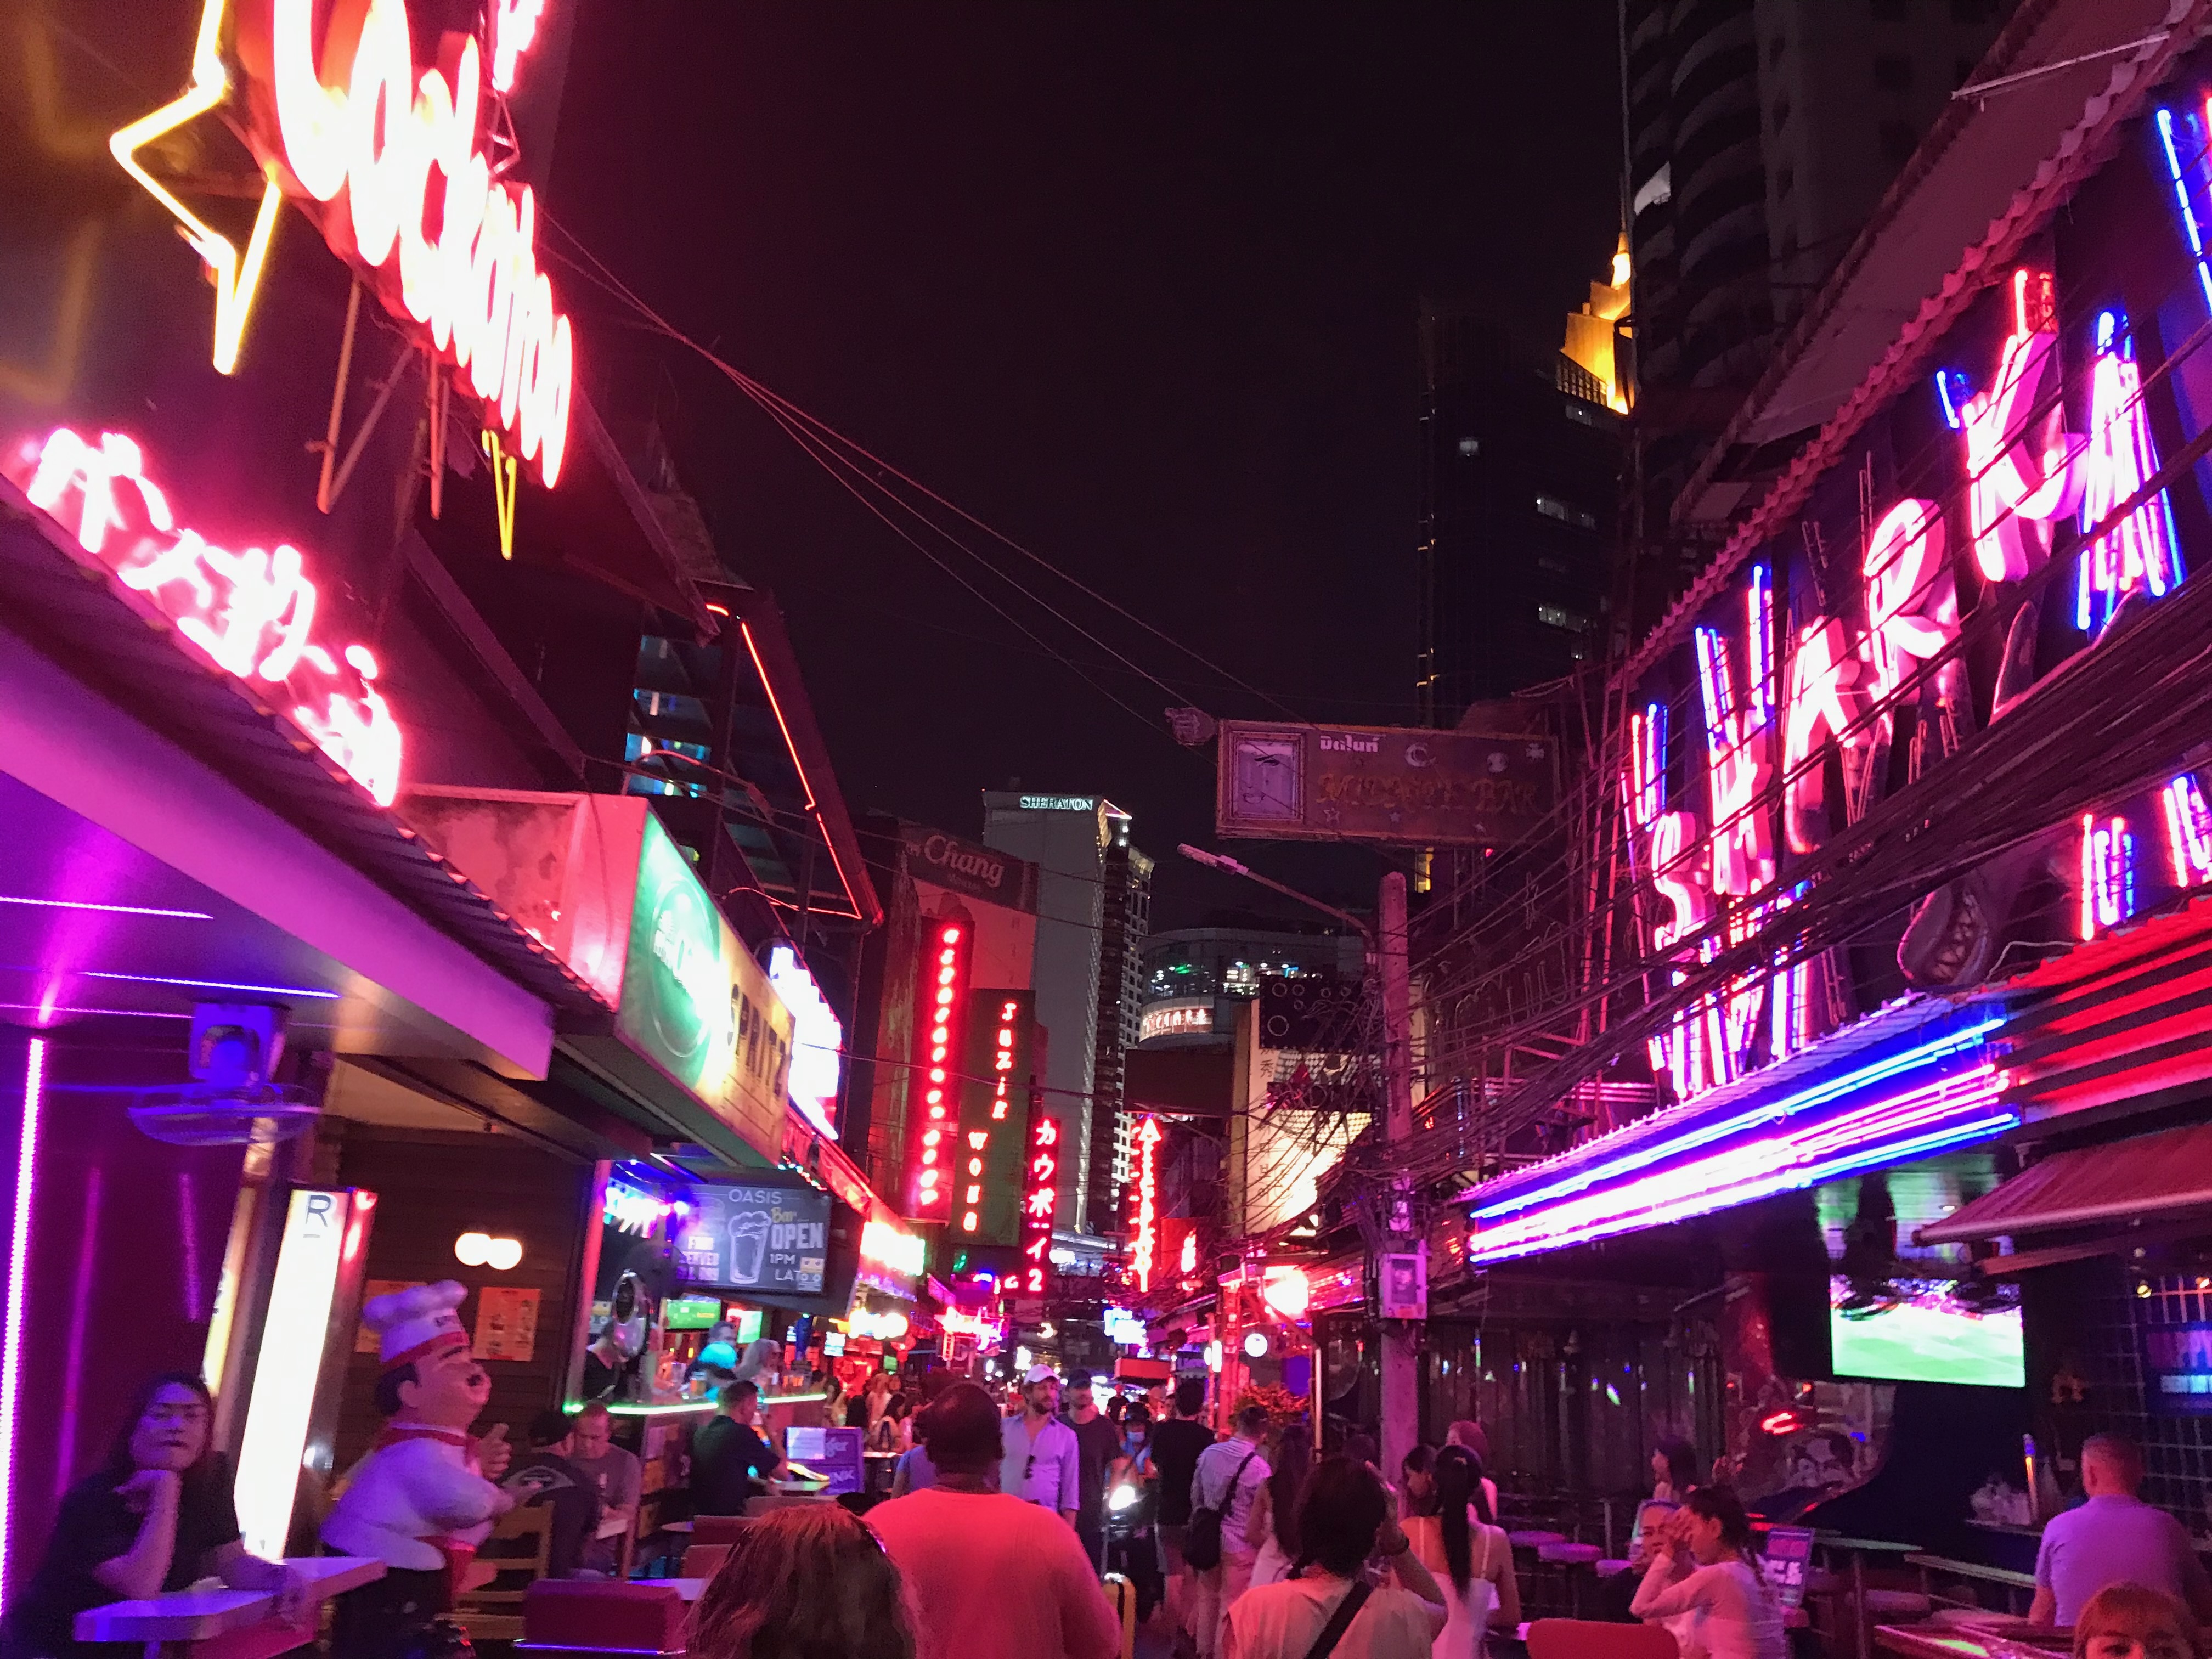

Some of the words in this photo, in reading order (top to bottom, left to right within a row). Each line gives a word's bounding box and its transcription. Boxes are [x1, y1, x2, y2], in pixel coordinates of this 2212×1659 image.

[1650, 331, 2089, 959] SHARK
[1020, 795, 1093, 811] SHERATON
[924, 834, 1005, 888] Chang
[729, 1189, 782, 1204] OASIS
[771, 1222, 824, 1250] OPEN
[770, 1254, 795, 1265] 1PM
